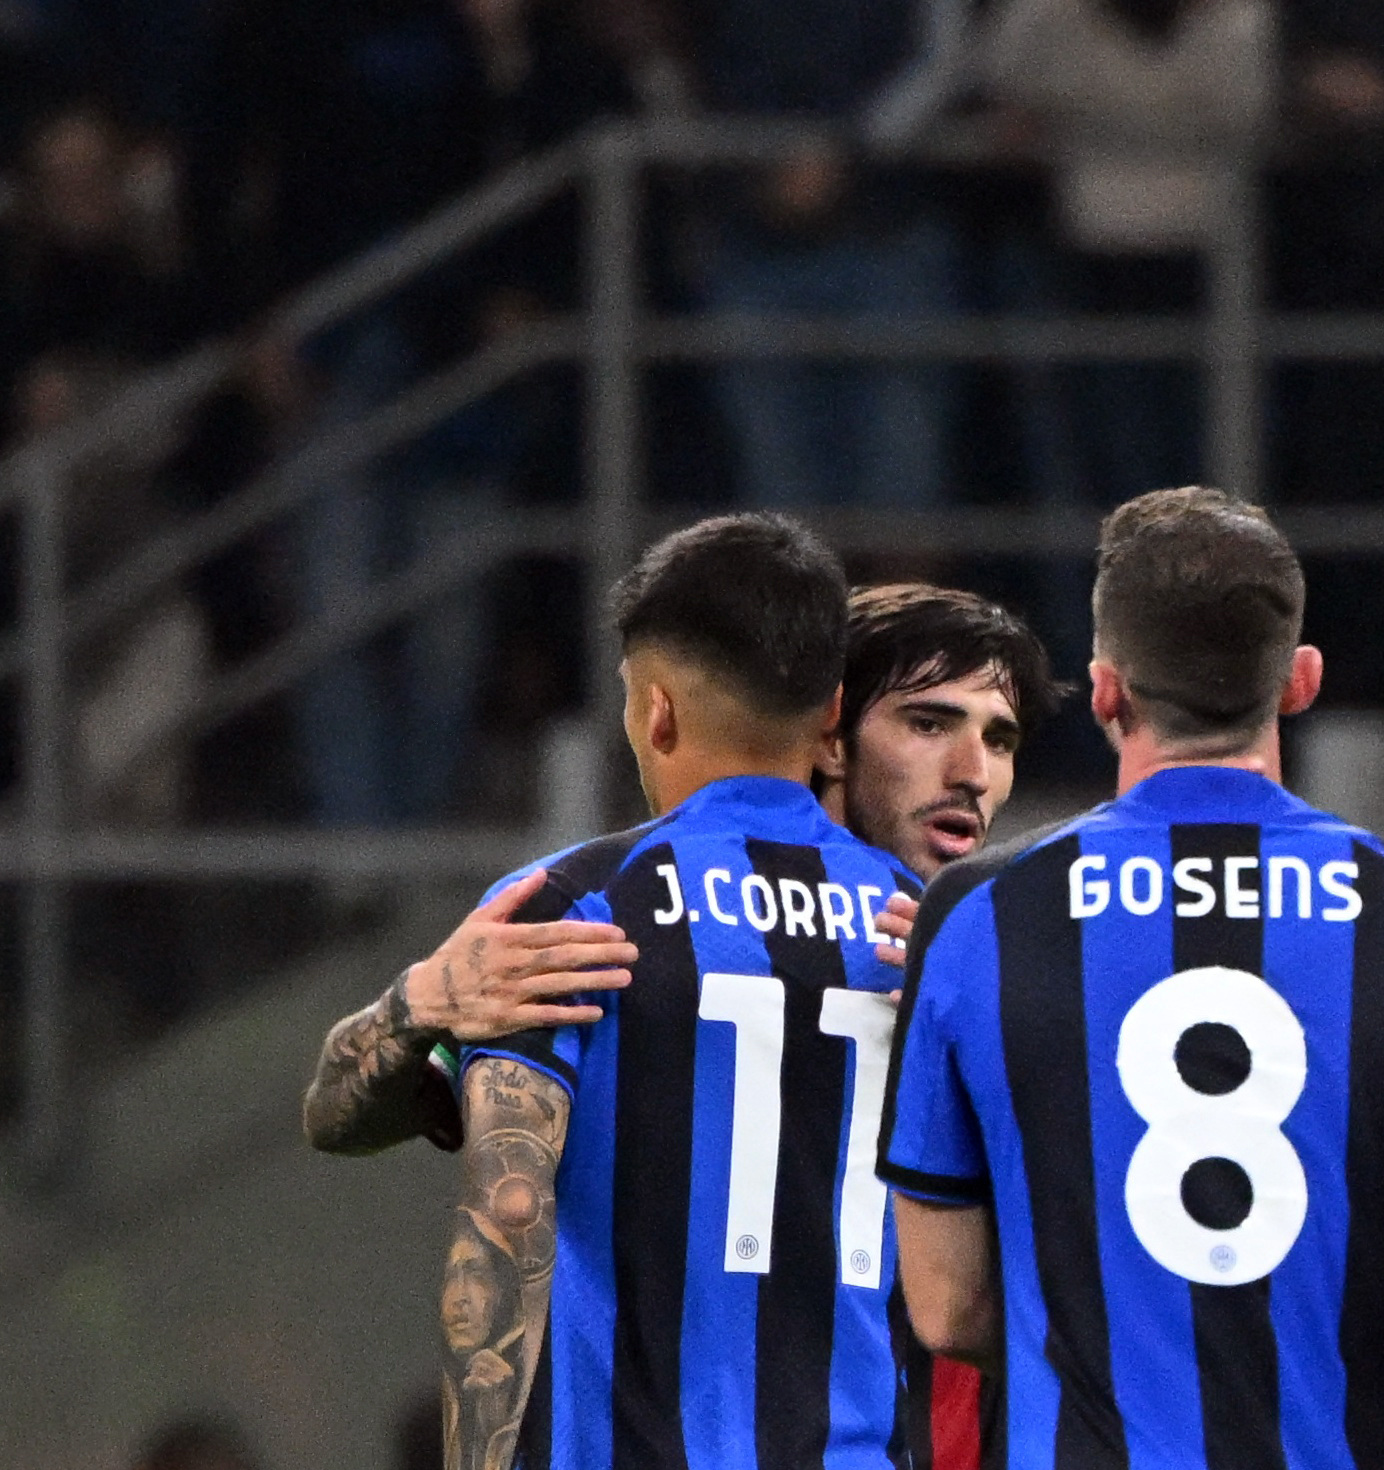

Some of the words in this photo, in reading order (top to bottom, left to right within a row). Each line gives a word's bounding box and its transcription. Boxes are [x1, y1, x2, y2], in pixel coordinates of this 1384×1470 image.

[652, 863, 913, 951] J.CORRE
[1068, 854, 1363, 922] GOSENS
[698, 972, 899, 1290] 11
[1116, 965, 1309, 1287] 8
